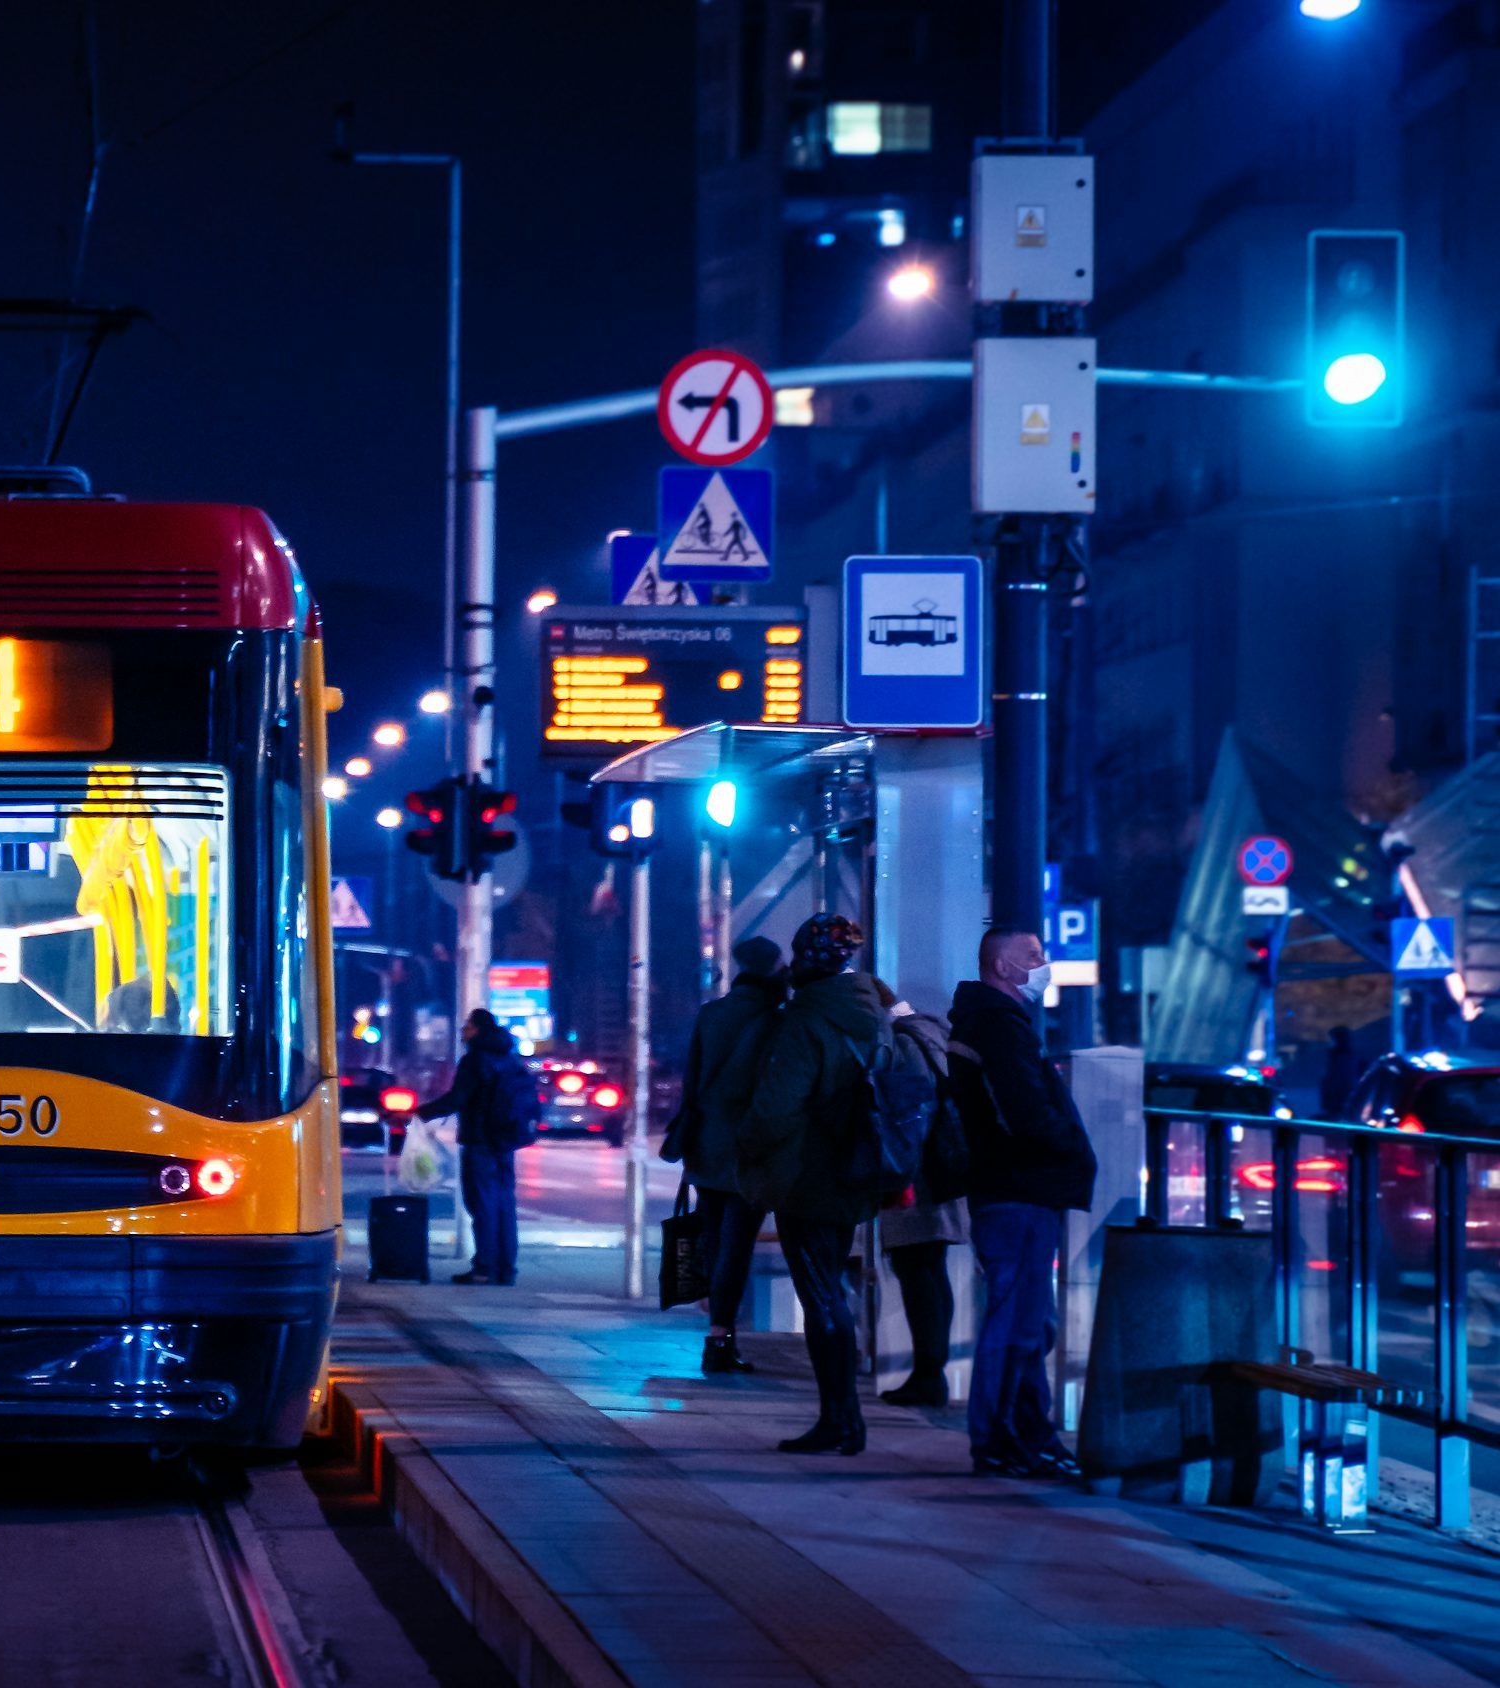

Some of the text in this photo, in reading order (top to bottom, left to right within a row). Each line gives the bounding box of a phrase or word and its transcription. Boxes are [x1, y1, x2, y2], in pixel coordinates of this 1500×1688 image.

[574, 625, 612, 641] Metro
[616, 623, 711, 644] Świętokrzyska
[1059, 910, 1086, 945] P
